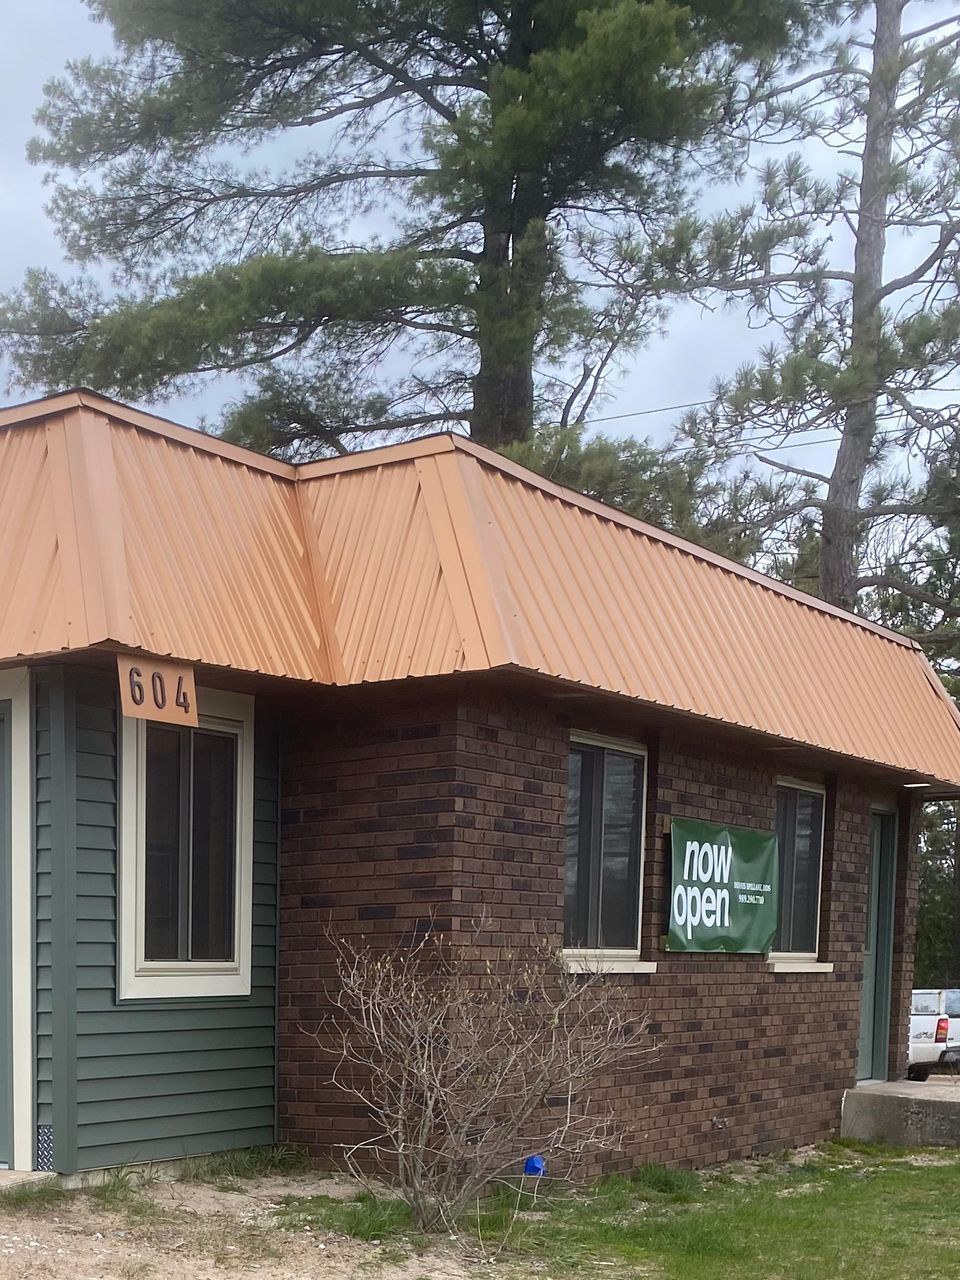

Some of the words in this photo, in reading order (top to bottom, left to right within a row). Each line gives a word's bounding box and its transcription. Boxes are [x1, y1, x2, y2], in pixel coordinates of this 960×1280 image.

[129, 667, 190, 714] 604
[683, 840, 732, 884] now
[673, 884, 730, 940] open
